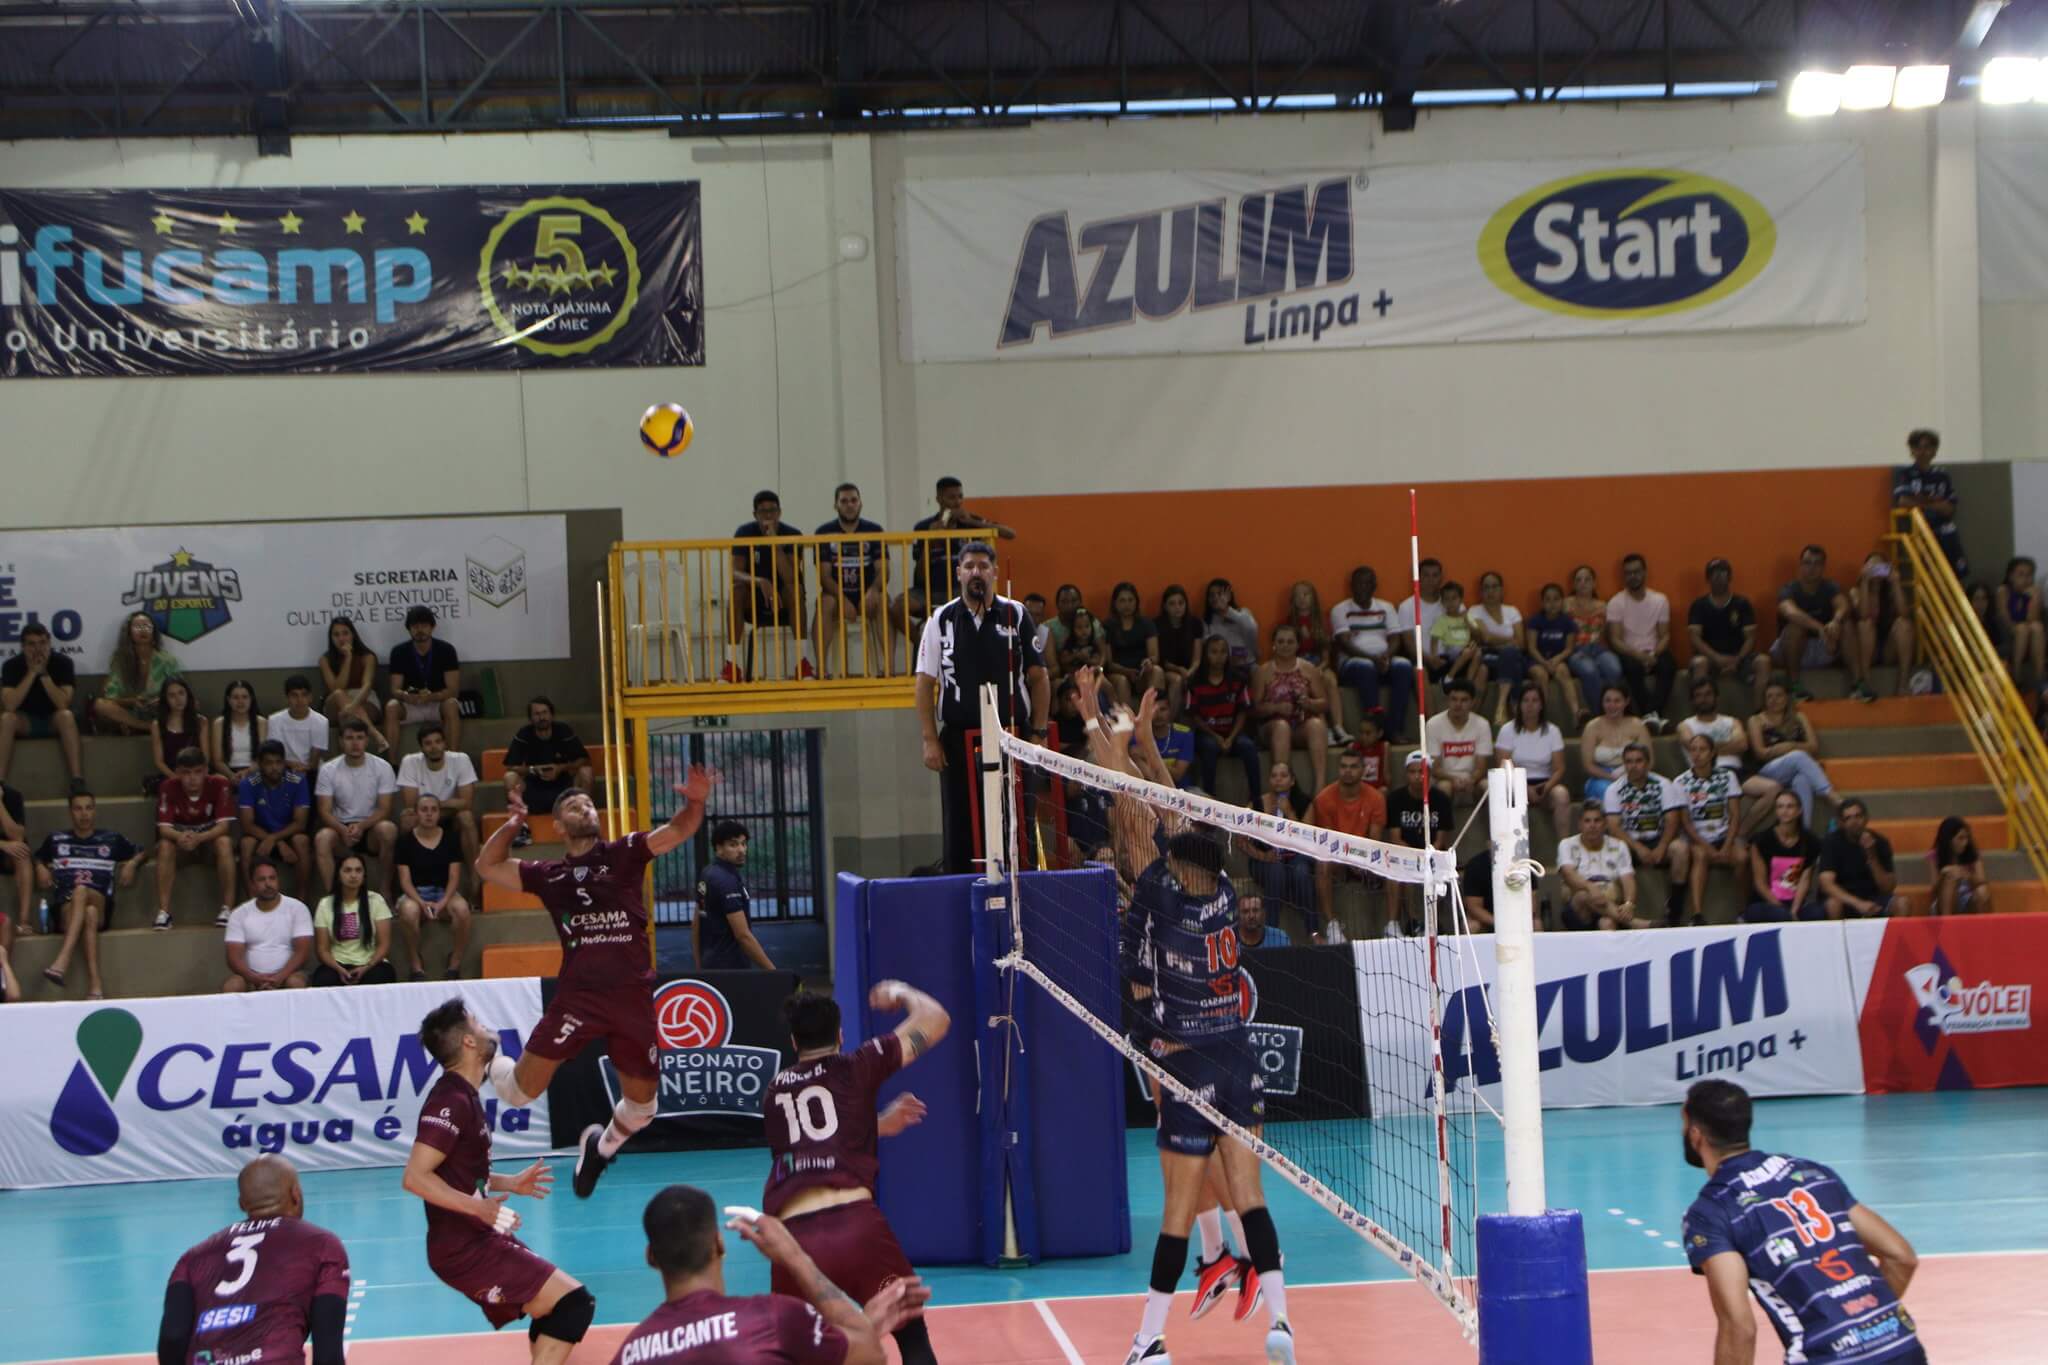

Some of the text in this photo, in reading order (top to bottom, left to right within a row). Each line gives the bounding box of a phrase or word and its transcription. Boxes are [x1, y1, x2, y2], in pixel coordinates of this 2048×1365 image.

[1533, 201, 1724, 284] Start
[997, 176, 1355, 348] AZULIM
[512, 300, 612, 315] NOTA MÁXIMA
[1244, 293, 1360, 345] Limpa
[54, 319, 370, 352] Universitário
[560, 319, 589, 331] MEC
[121, 569, 242, 606] JOVENS
[354, 567, 459, 587] SECRETARIA
[332, 588, 460, 608] DE JUVENTUDE,
[370, 607, 380, 622] E
[1401, 810, 1440, 823] BOS
[576, 887, 592, 907] 5
[570, 909, 628, 926] CESAMA
[1204, 926, 1238, 973] 10
[1424, 928, 1790, 1099] AZULIM
[1961, 981, 2026, 1016] VÔLEI
[660, 1053, 763, 1070] PEONATO
[1676, 1033, 1777, 1081] Limpa
[661, 1070, 761, 1096] NEIRO
[222, 1109, 353, 1153] água
[375, 1105, 401, 1142] é
[775, 1085, 839, 1145] 10
[230, 1217, 282, 1232] FELIPE
[1769, 1187, 1835, 1248] 13
[214, 1232, 266, 1296] 3
[201, 1305, 250, 1330] SESI
[621, 1312, 739, 1365] CAVALCANTE
